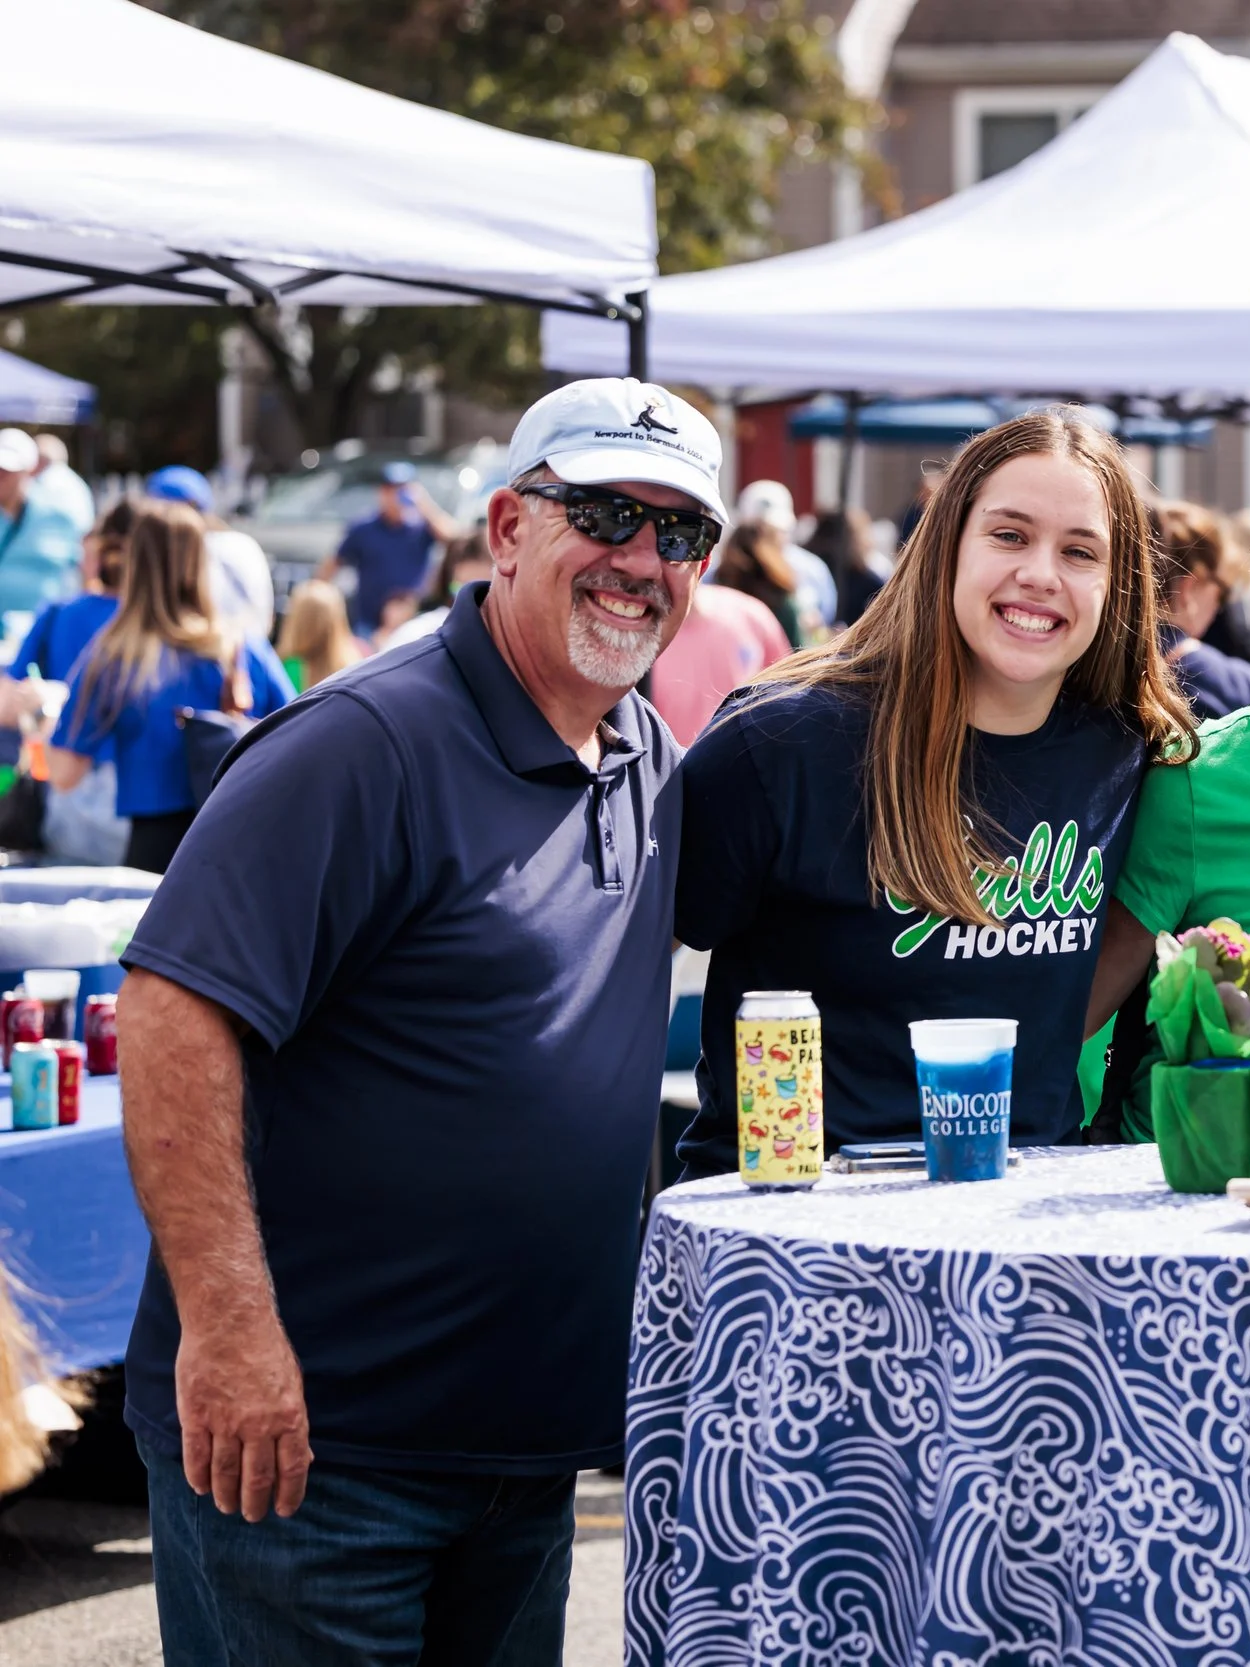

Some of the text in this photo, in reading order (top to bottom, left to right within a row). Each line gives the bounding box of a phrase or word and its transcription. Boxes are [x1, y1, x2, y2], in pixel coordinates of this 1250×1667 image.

[594, 430, 633, 439] Newport
[635, 432, 645, 440] to
[646, 434, 685, 452] Bermuda
[943, 916, 1097, 959] HOCKEY
[921, 1085, 1012, 1118] ENDICOTT
[929, 1117, 1007, 1136] COLLEGE
